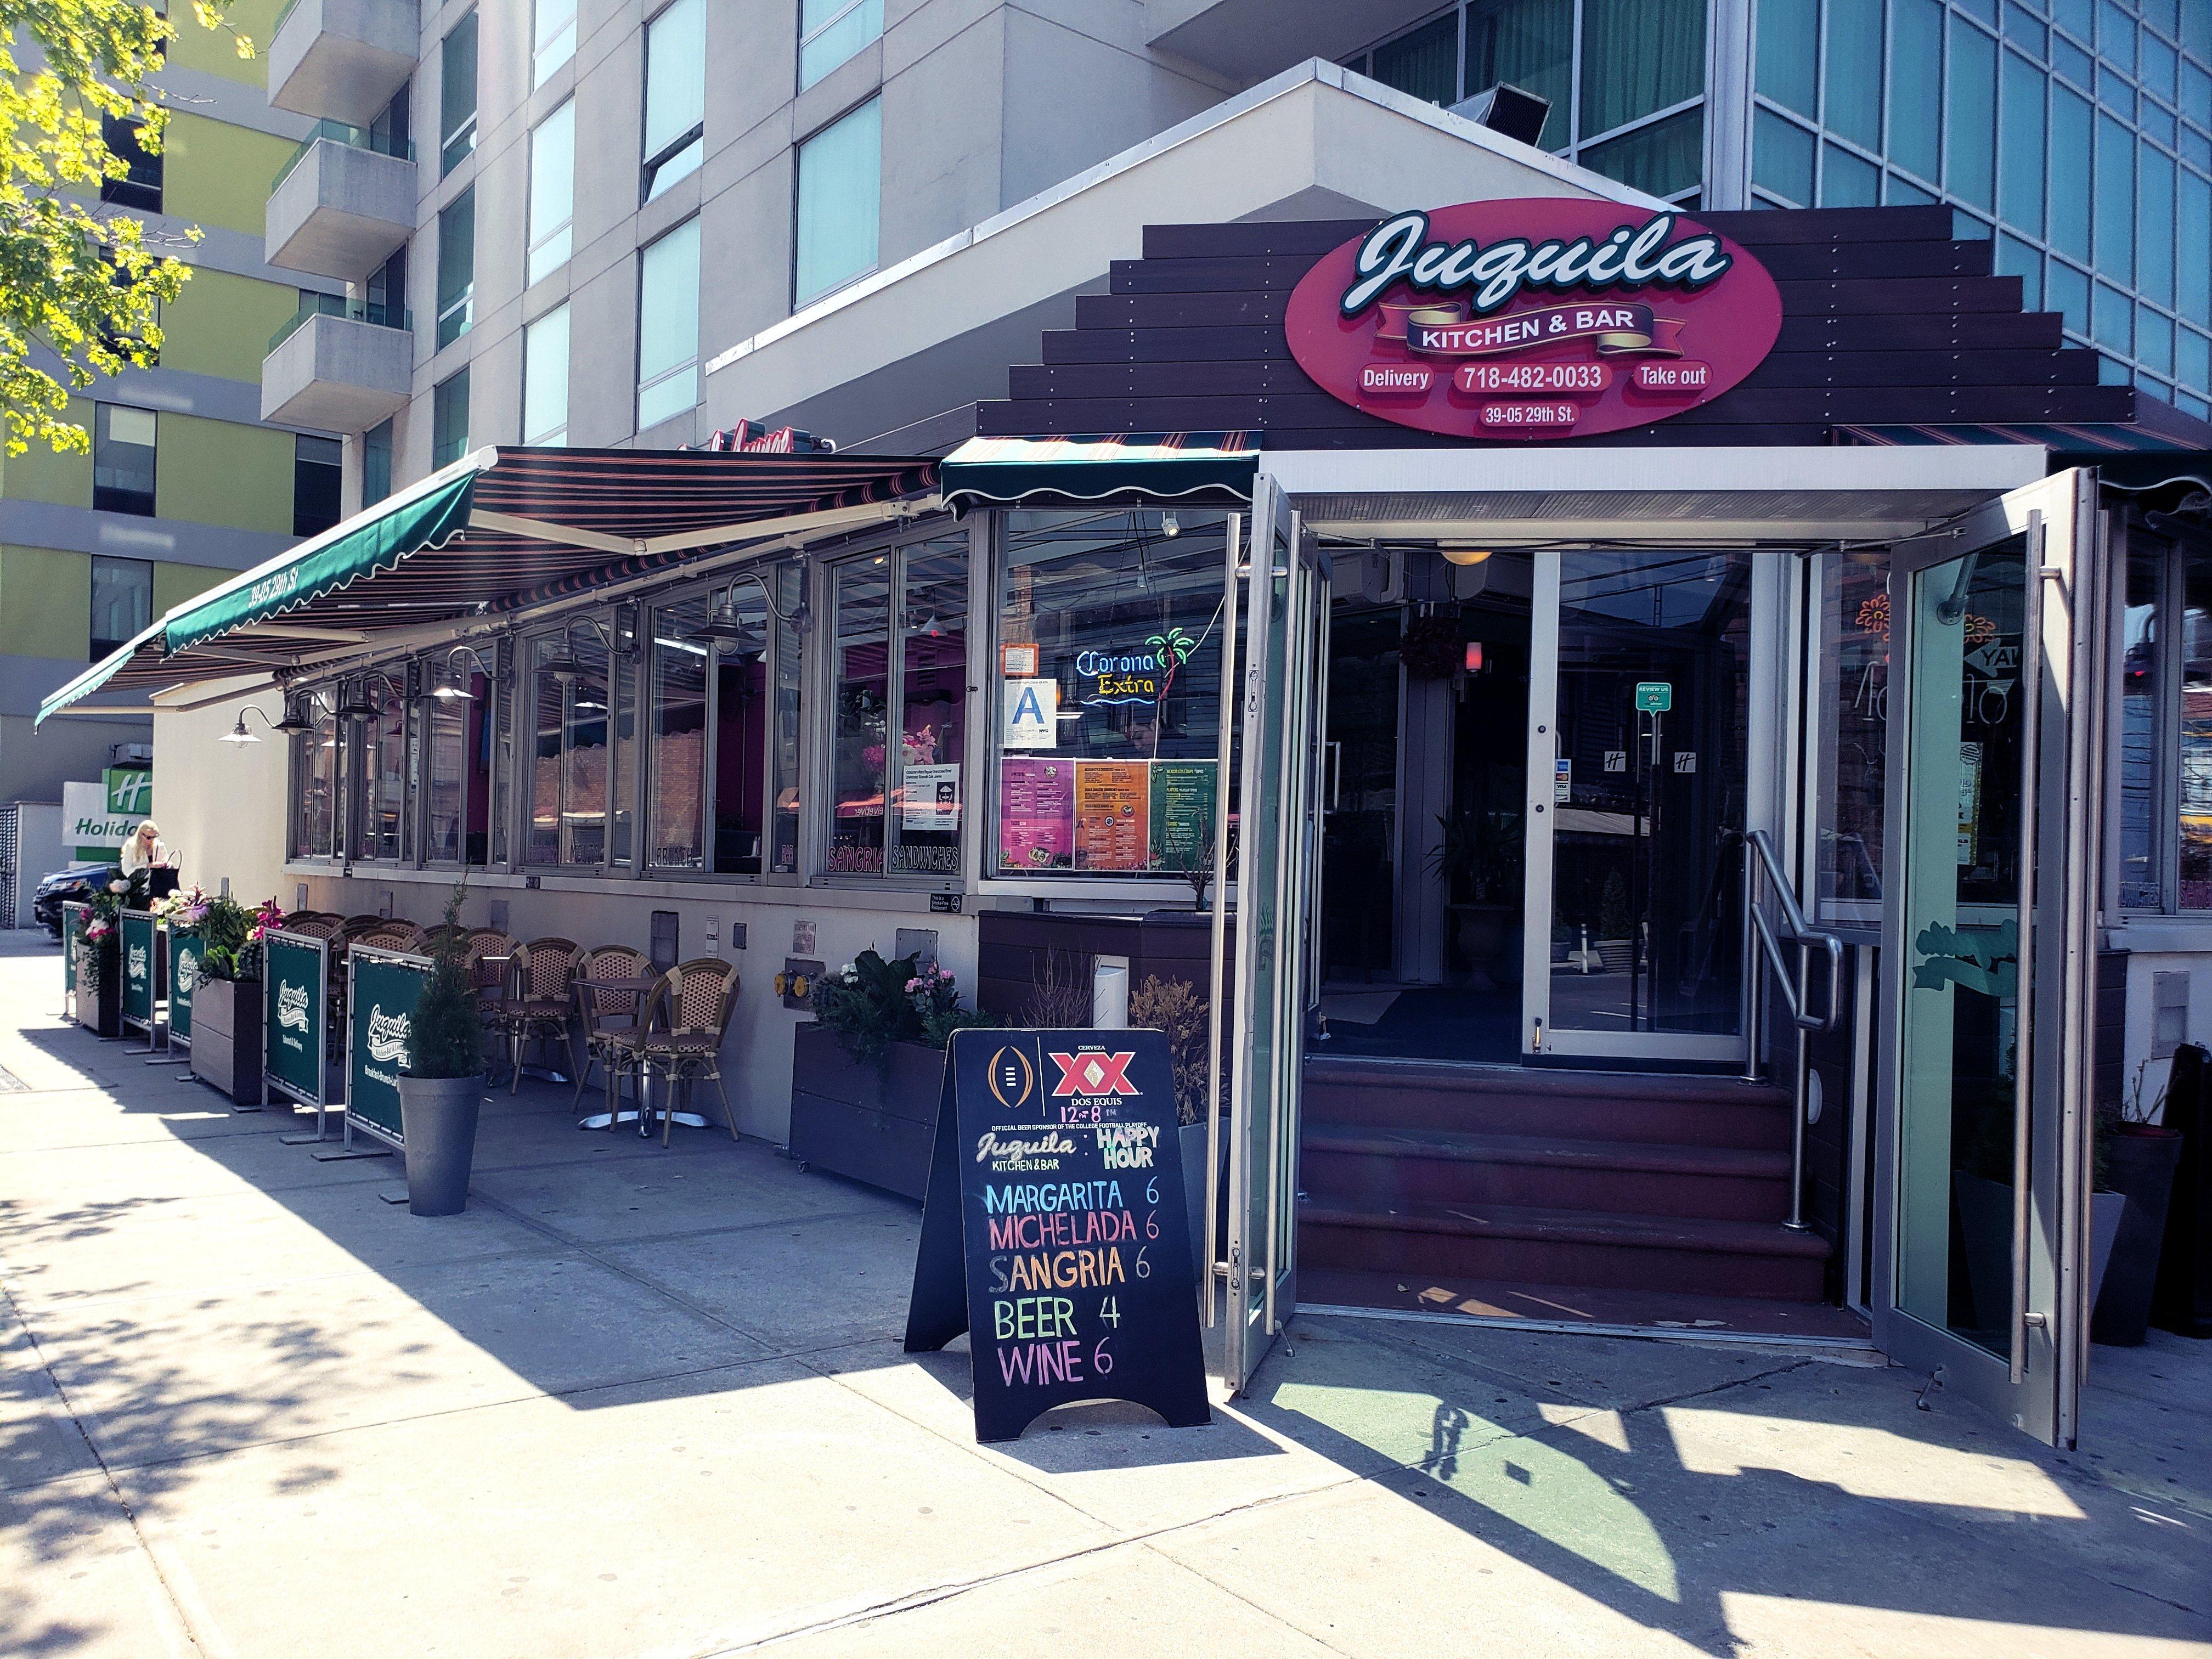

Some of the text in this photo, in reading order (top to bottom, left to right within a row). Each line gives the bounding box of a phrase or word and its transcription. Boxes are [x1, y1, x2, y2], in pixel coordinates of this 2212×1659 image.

[1341, 212, 1731, 313] Juquila
[1422, 309, 1634, 348] KITCHEN & BAR
[1363, 369, 1429, 389] Delivery
[1464, 366, 1601, 388] 718-482-0033
[1641, 366, 1706, 385] Take out
[1486, 406, 1575, 422] 39-05 29th St.
[248, 565, 299, 608] 39-05 29th St
[1076, 651, 1154, 676] Corona
[1098, 673, 1154, 695] Extra
[1012, 687, 1045, 724] A
[893, 845, 959, 871] SANDWICHES
[279, 979, 308, 1011] Juquila
[368, 1003, 412, 1042] Juquila
[1071, 1098, 1091, 1106] DOS
[976, 1131, 1077, 1163] Juquila
[1097, 1126, 1160, 1149] HAPPY
[992, 1158, 1060, 1172] KITCHEN & BAR
[1103, 1147, 1154, 1170] HOUR
[986, 1176, 1159, 1214] MARGARITA 6
[989, 1209, 1159, 1251] MICHELADA 6
[988, 1245, 1151, 1293] SANGRIA 6
[994, 1296, 1121, 1340] BEER 4
[997, 1336, 1113, 1387] WINE 6
